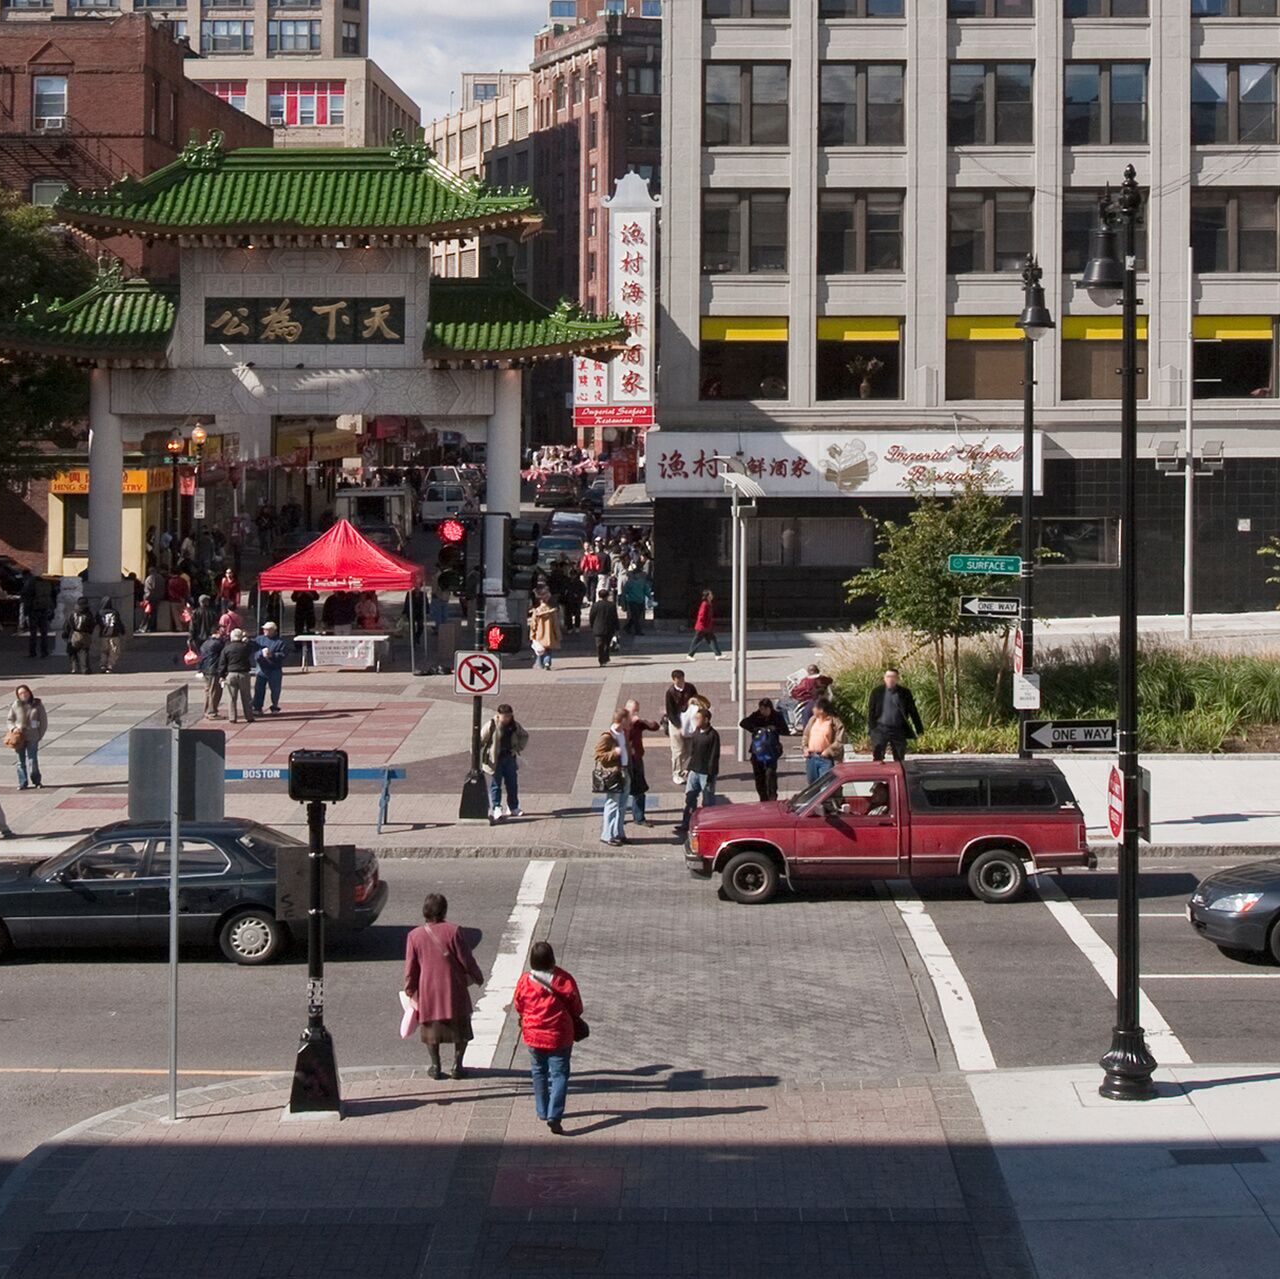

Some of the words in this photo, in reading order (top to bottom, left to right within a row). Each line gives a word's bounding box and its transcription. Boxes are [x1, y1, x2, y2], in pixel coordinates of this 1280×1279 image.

[621, 222, 645, 393] 漁村海鮮酒家
[581, 407, 615, 416] Imperial
[615, 407, 648, 417] Seafood
[658, 449, 811, 480] 漁村鮮酒家
[966, 561, 1006, 571] SURFACE
[998, 602, 1016, 610] WAY
[1052, 729, 1077, 740] ONE
[1083, 728, 1110, 740] WAY
[242, 769, 281, 779] BOSTON
